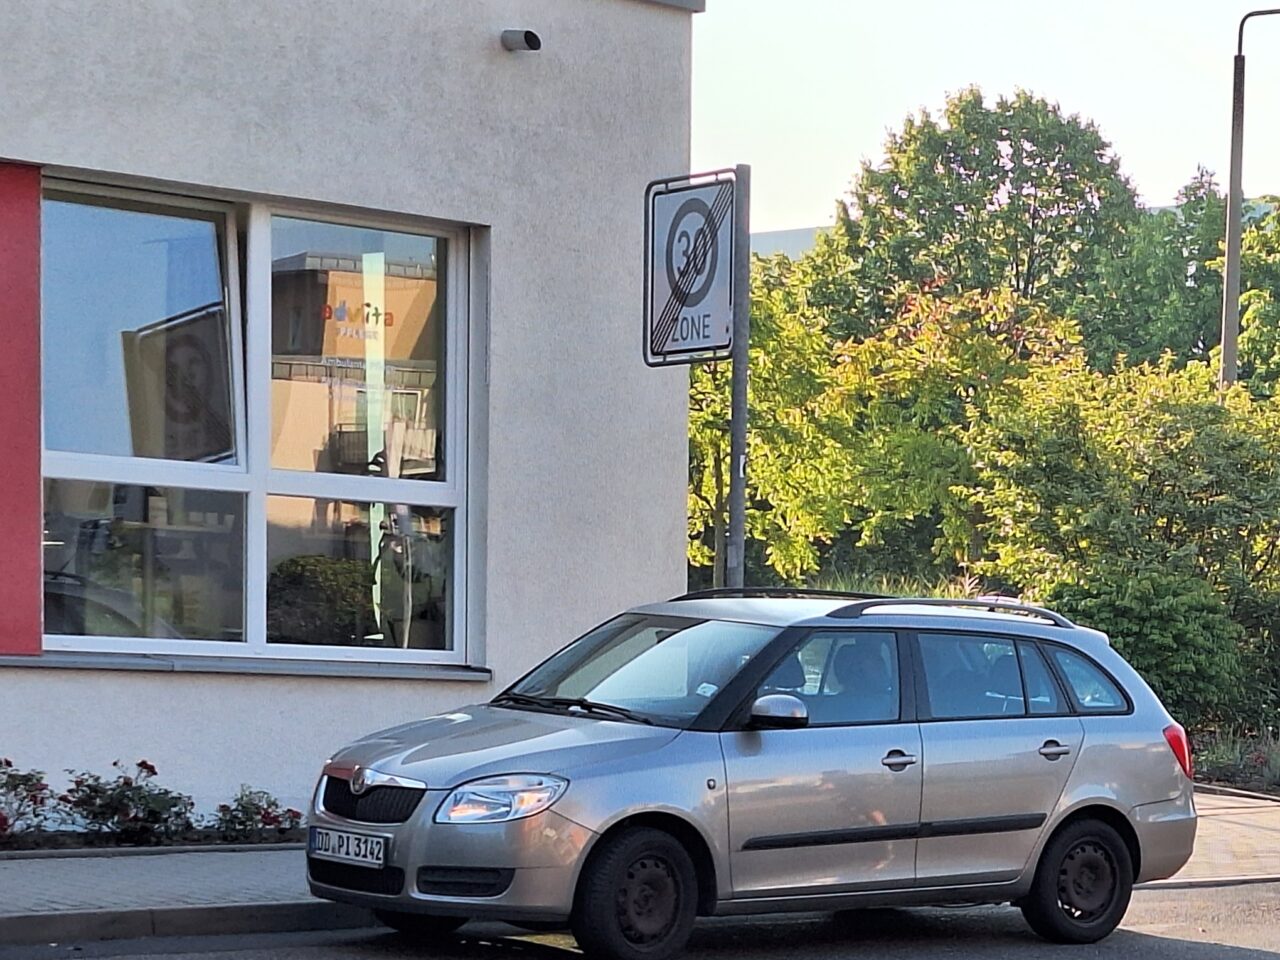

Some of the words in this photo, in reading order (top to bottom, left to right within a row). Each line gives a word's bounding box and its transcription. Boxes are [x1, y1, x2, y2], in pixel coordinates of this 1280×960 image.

[677, 227, 707, 277] 30
[671, 314, 711, 343] ZONE
[317, 831, 330, 852] DD
[338, 835, 350, 856] PI
[354, 837, 382, 861] 3142
